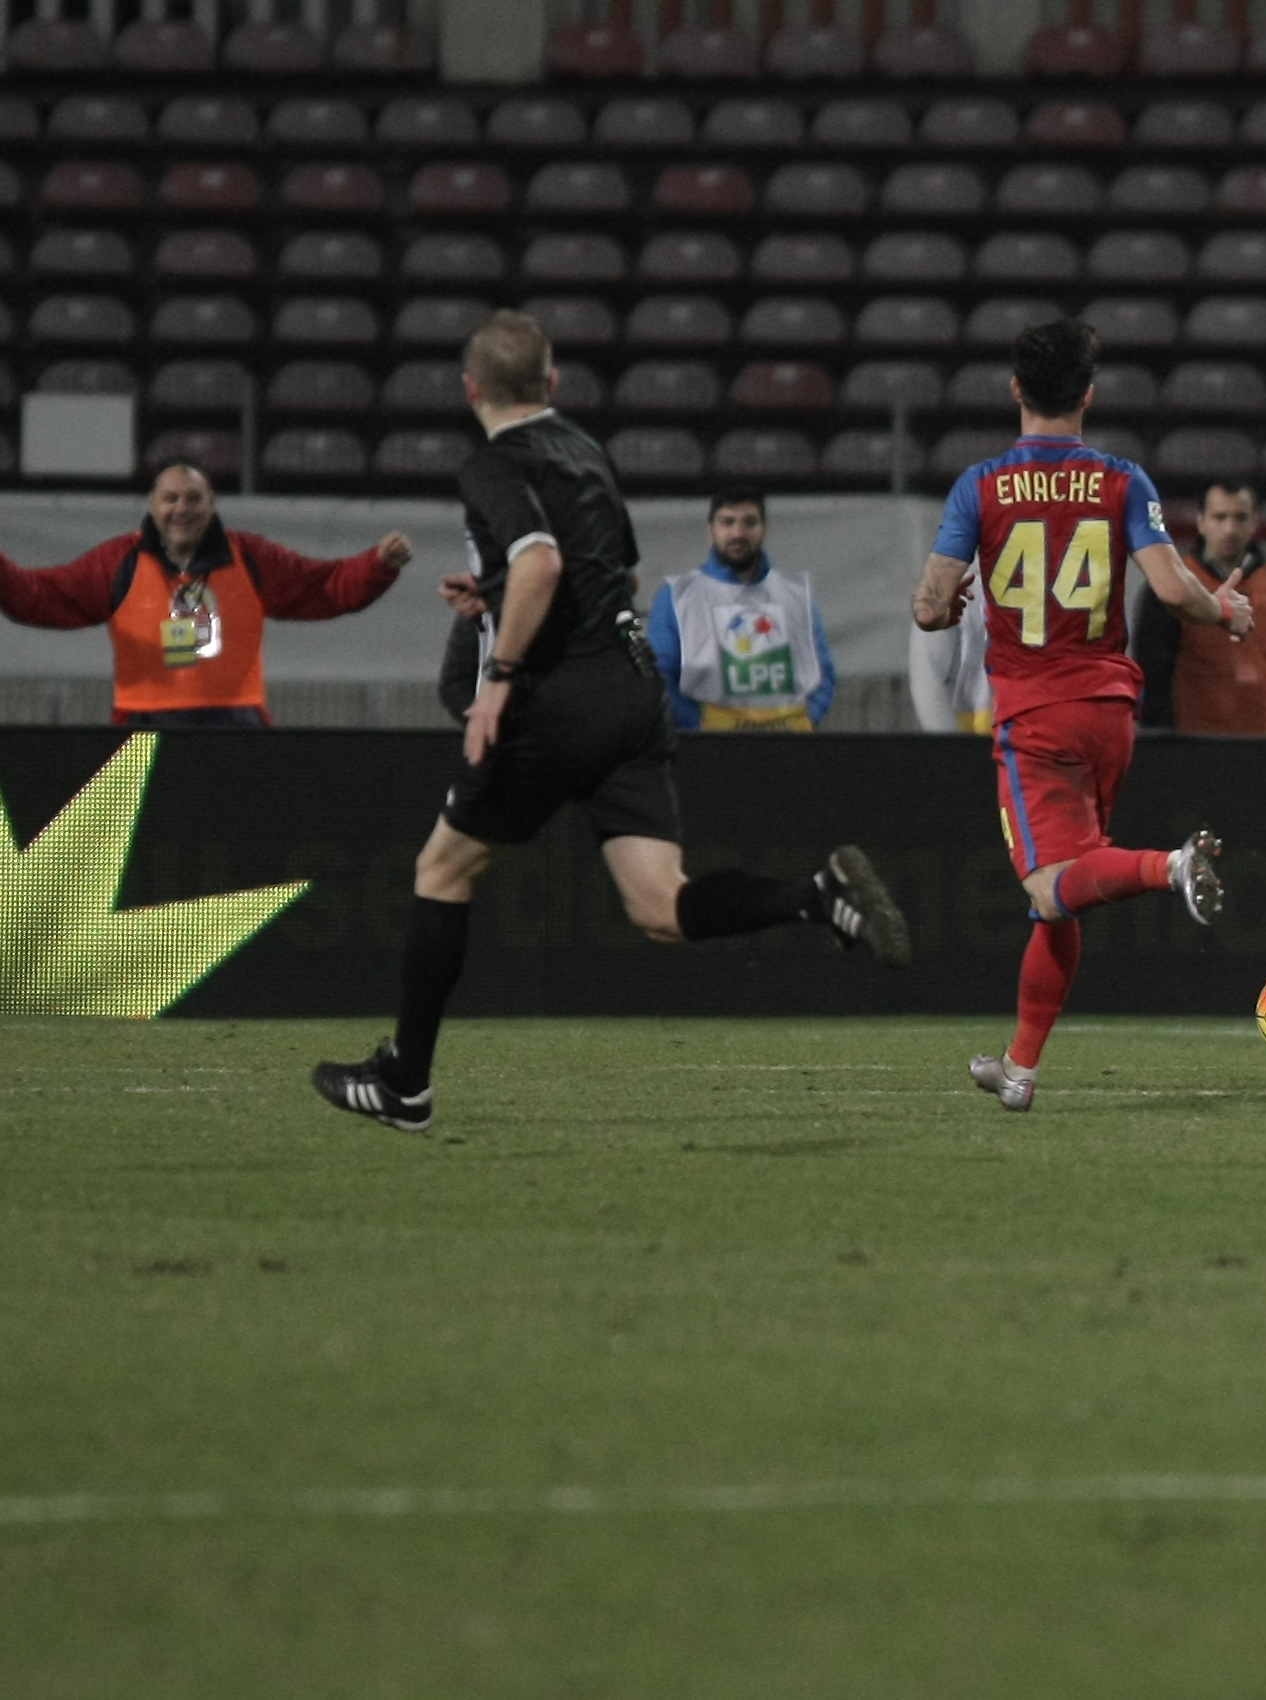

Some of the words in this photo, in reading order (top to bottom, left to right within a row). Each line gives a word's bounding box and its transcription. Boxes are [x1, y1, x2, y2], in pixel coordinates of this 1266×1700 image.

[996, 470, 1104, 505] ENACHE
[988, 519, 1112, 647] 44
[728, 662, 786, 693] LPF
